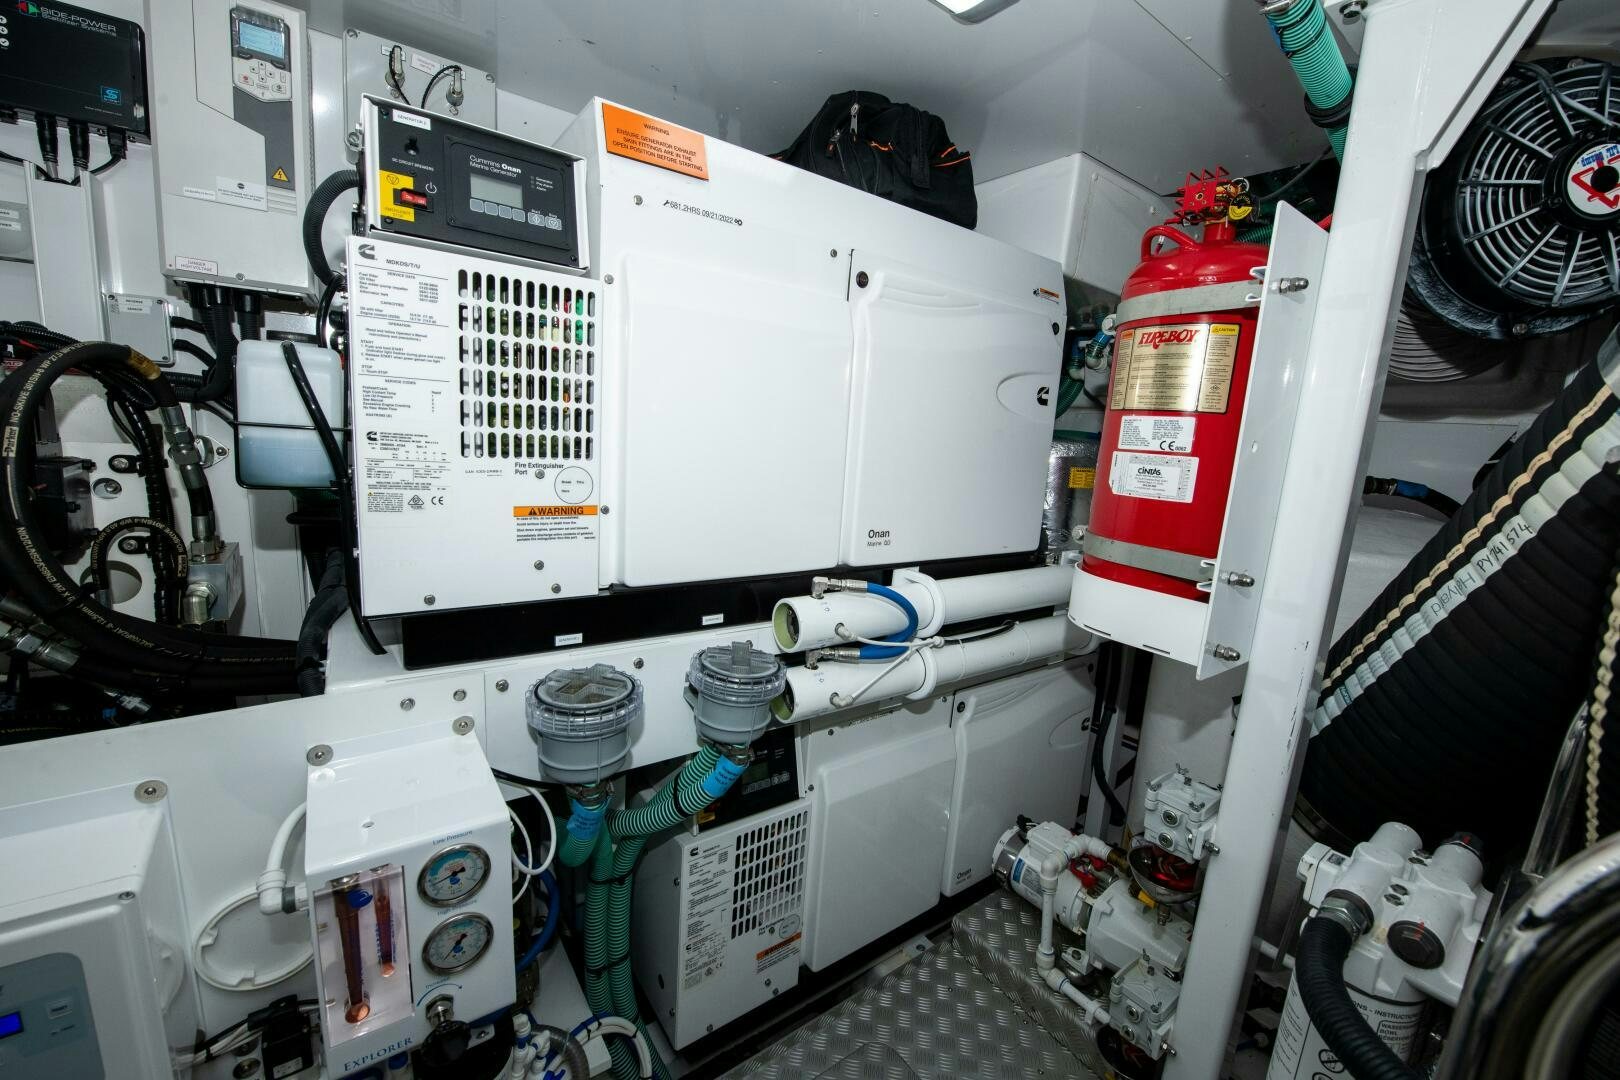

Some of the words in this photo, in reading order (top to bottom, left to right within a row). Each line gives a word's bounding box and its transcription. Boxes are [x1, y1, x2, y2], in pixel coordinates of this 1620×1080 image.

[40, 6, 117, 32] SIDE-POWER
[643, 122, 670, 136] WARNING
[616, 127, 640, 140] ENSURE
[640, 133, 673, 150] GENERATOR
[674, 144, 697, 157] EXHAUST
[638, 140, 663, 153] FITTINGS
[663, 148, 675, 157] ARE
[469, 154, 501, 170] Cummins
[501, 163, 522, 174] Onan
[612, 140, 628, 150] OPEN
[629, 144, 656, 158] POSITION
[656, 152, 678, 165] BEFORE
[678, 159, 703, 172] STARTING
[469, 161, 489, 172] Marine
[489, 166, 518, 179] Generator
[1138, 328, 1200, 350] FIREBOY
[9, 388, 31, 424] NO-SKIVE
[514, 461, 527, 469] Fire
[527, 462, 565, 471] Extinguisher
[537, 506, 585, 516] WARNING
[867, 529, 890, 539] Onan
[432, 837, 447, 846] Low
[446, 830, 473, 841] Pressure
[343, 1036, 414, 1073] EXPLORER
